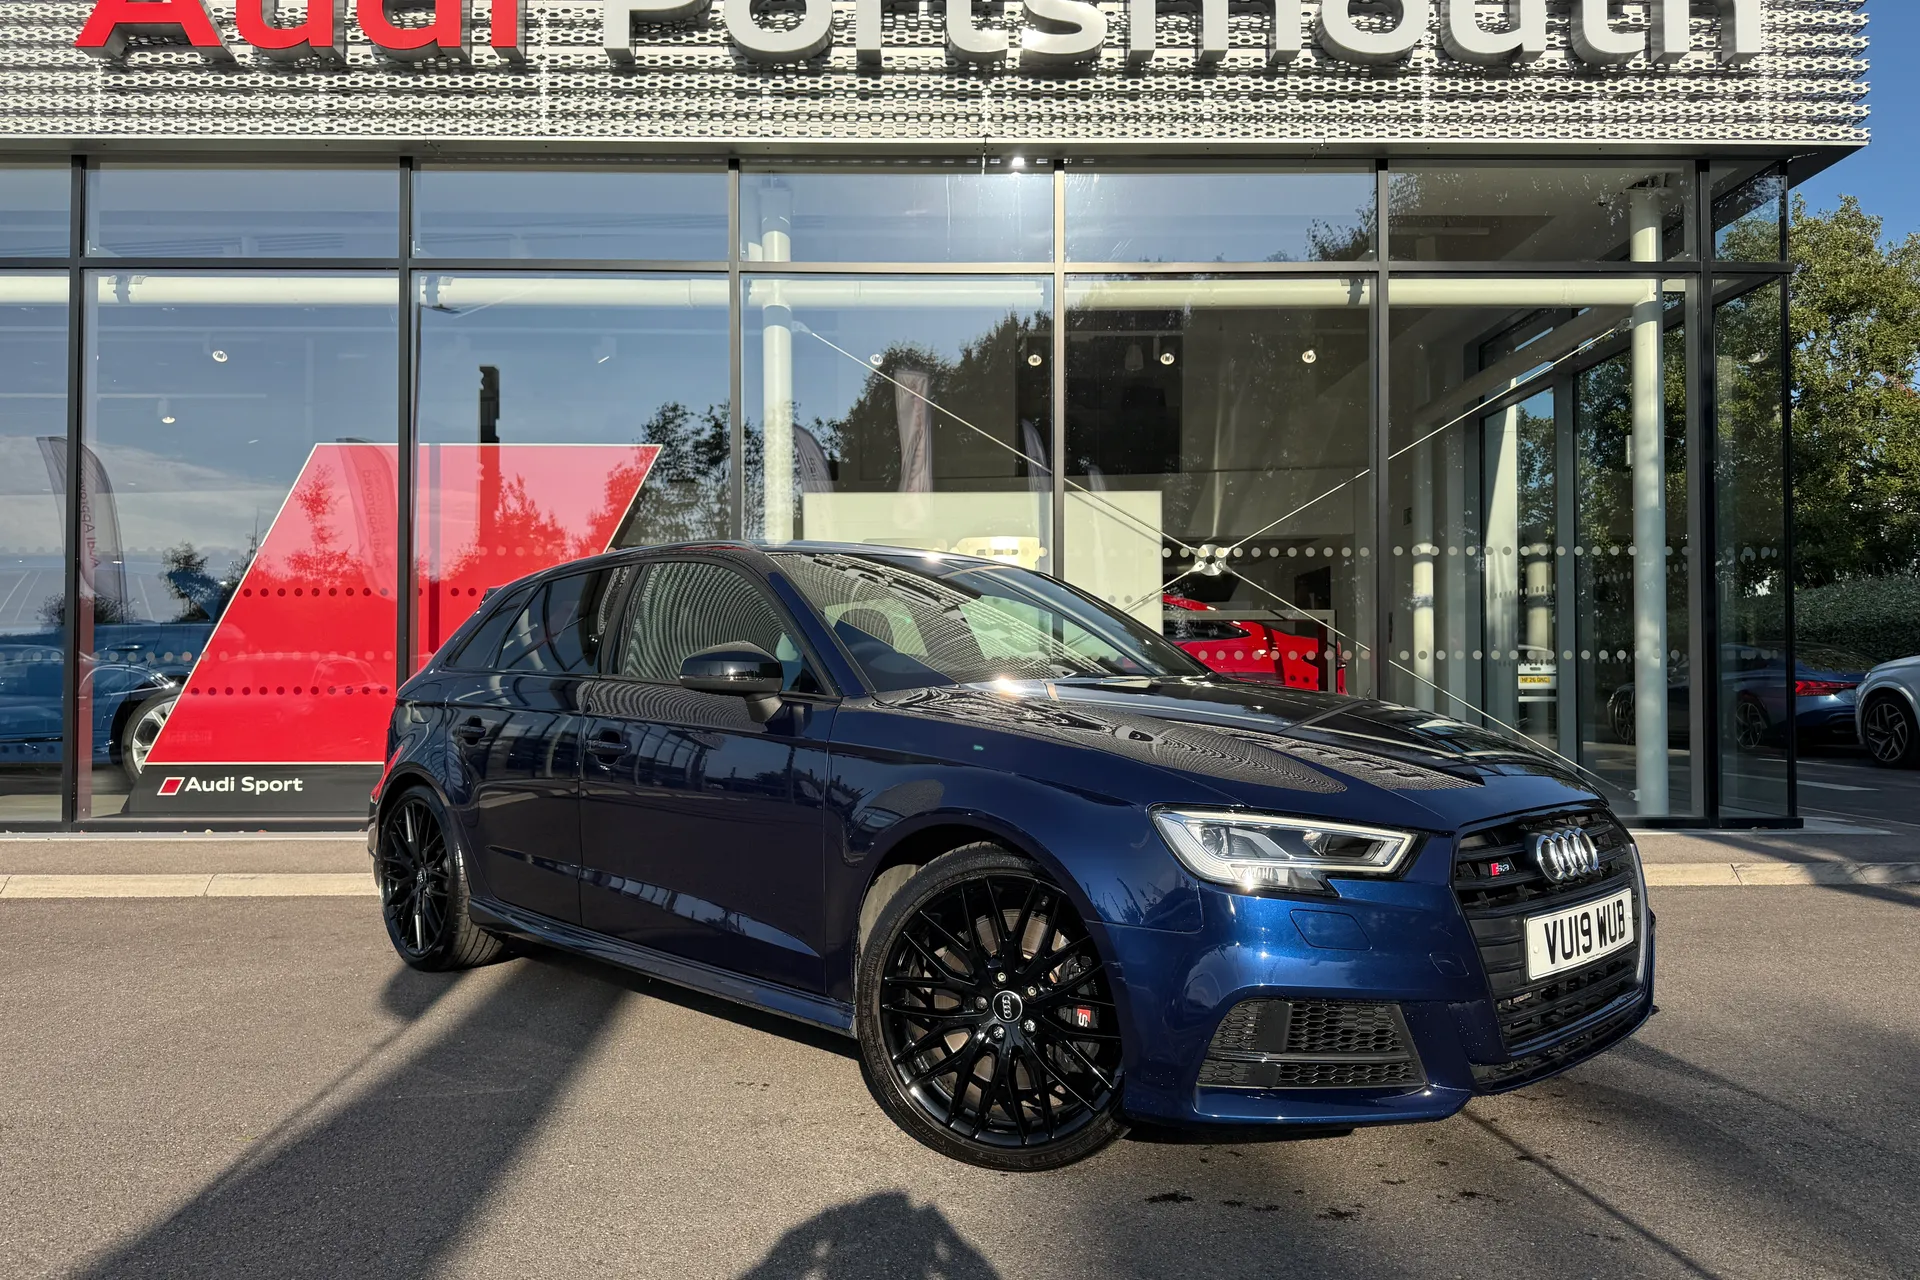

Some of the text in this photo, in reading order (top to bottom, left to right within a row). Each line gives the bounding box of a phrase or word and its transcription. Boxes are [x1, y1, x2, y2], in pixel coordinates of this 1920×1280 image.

[184, 776, 303, 795] Audi Sport
[1544, 899, 1626, 965] VU19 WUB
